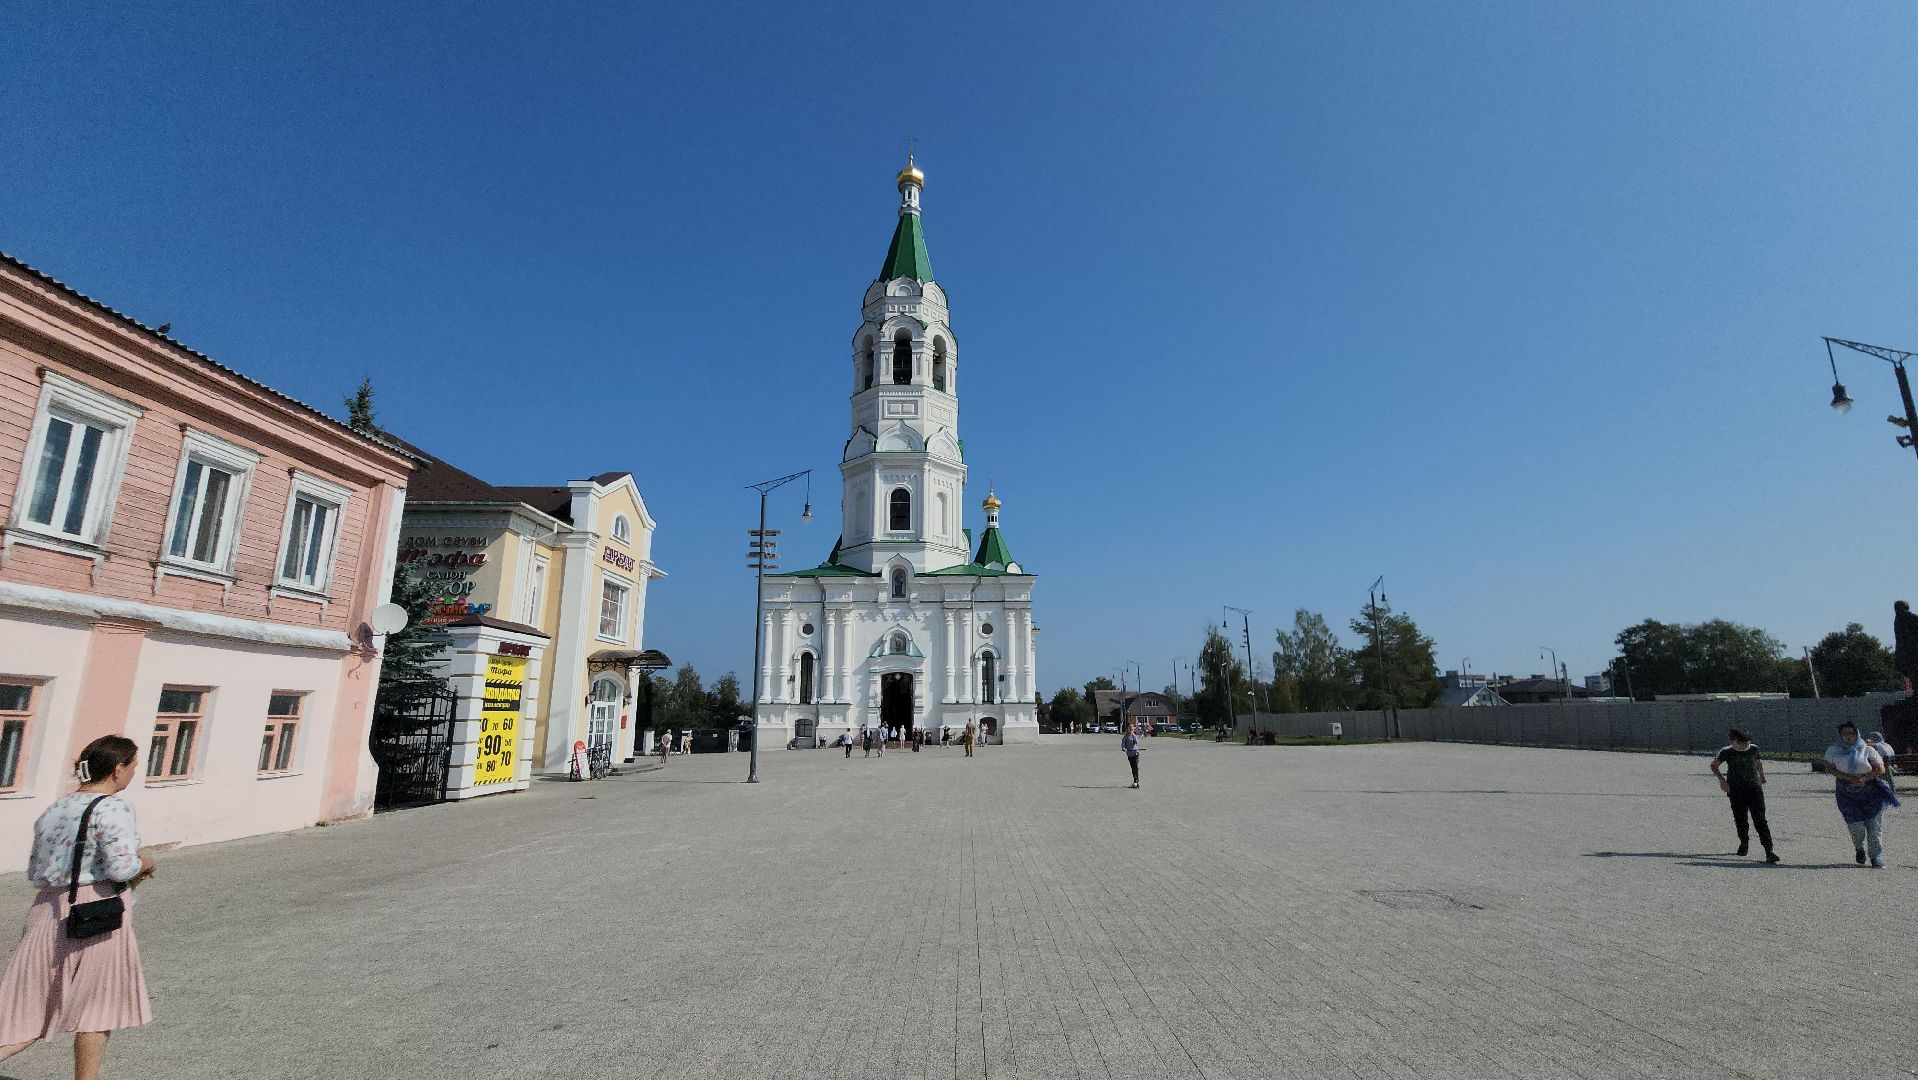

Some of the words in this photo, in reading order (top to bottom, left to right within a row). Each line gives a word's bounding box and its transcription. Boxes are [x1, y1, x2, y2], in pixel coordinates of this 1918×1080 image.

[406, 536, 438, 547] ДОМ
[443, 536, 489, 547] ОБУВИ
[427, 571, 468, 579] САЛОН
[502, 718, 514, 731] 60
[483, 734, 502, 757] 90
[500, 750, 512, 767] 70
